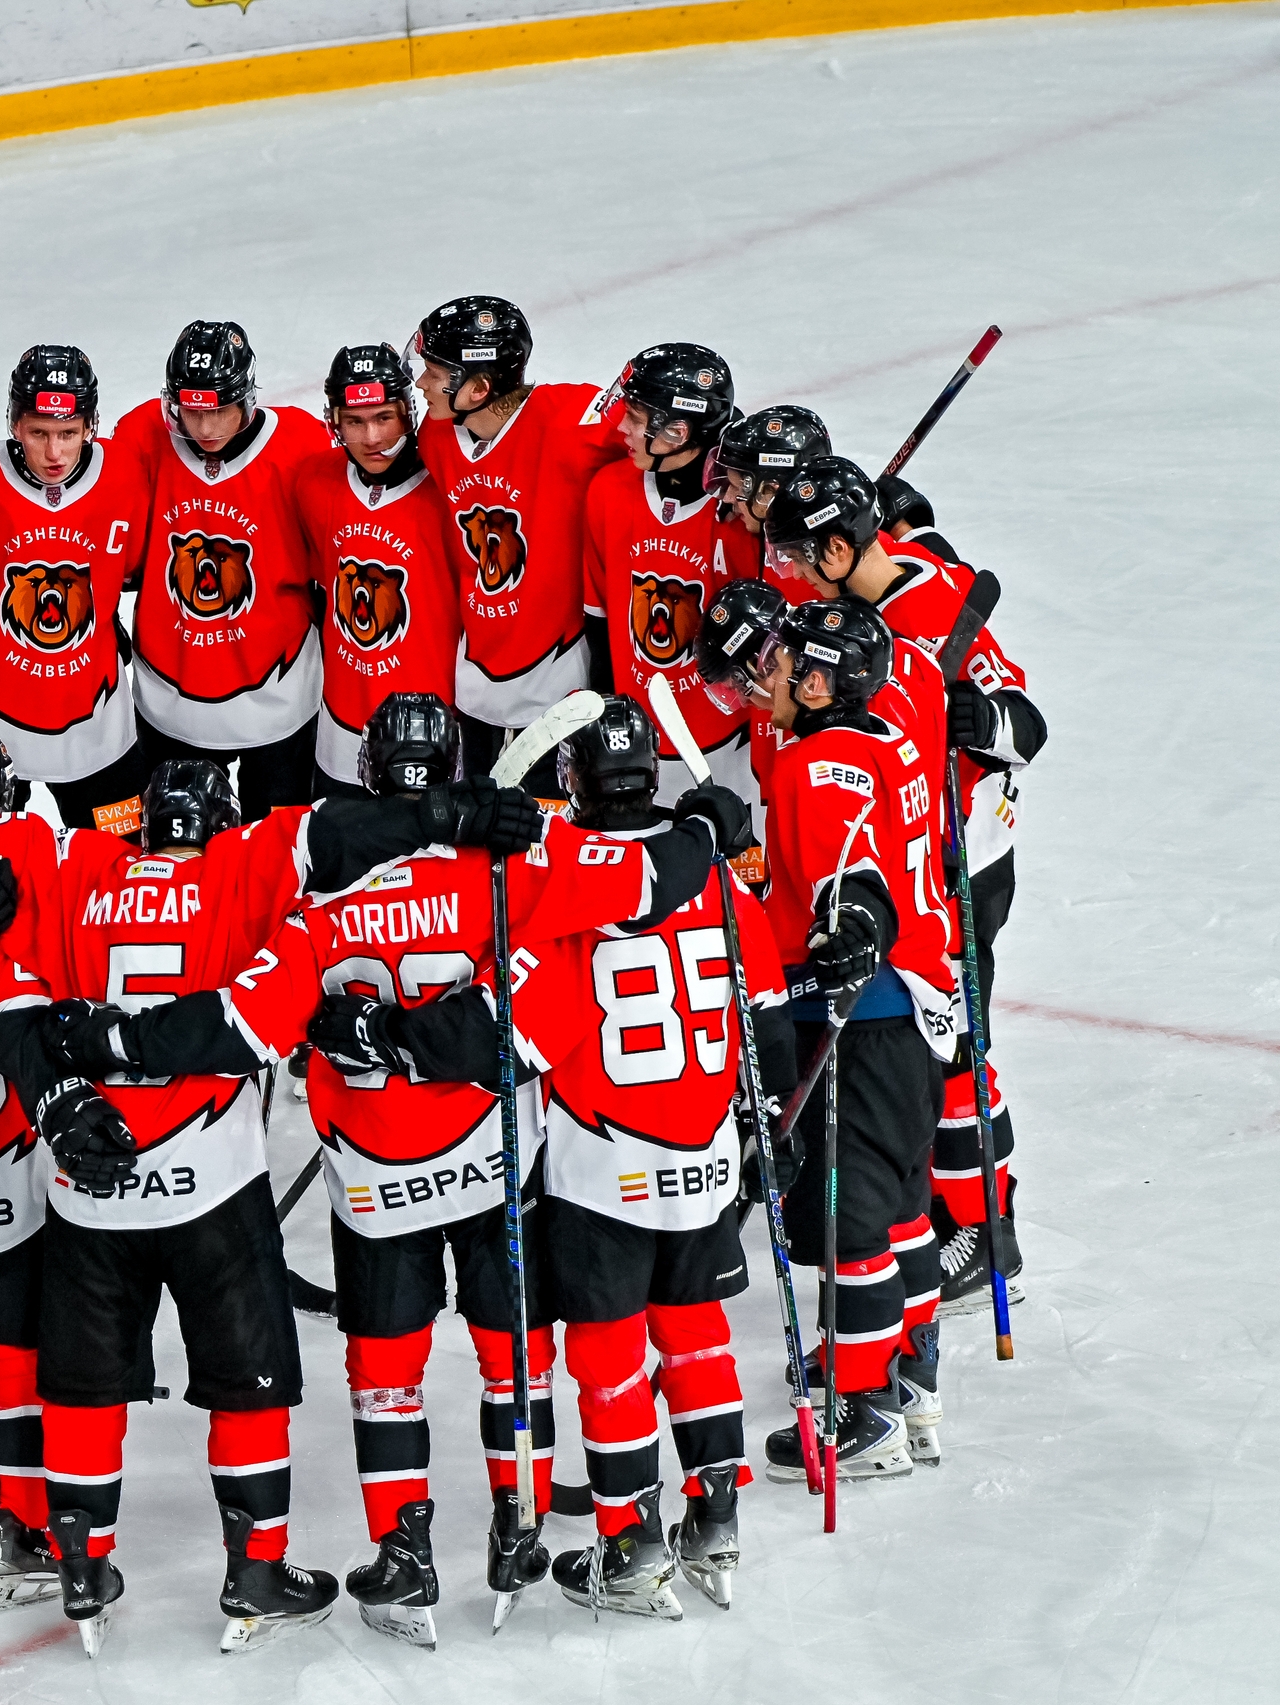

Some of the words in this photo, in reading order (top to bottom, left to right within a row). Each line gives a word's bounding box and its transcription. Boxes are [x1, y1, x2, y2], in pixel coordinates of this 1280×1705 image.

[189, 353, 212, 368] 23
[470, 351, 494, 359] ЕВРАЗ
[353, 360, 374, 373] 80
[47, 371, 67, 384] 48
[38, 404, 72, 413] OLIMPBET
[181, 400, 215, 408] OLIMPBET
[348, 396, 382, 405] OLIMPBET
[681, 400, 705, 410] ЕВРАЗ
[768, 456, 792, 464] ЕВРАЗ
[163, 498, 259, 536] КУЗНЕЦКИЕ
[813, 506, 837, 524] ЕВРАЗ
[106, 520, 130, 555] C
[333, 523, 414, 560] КУЗНЕЦКИЕ
[630, 537, 708, 575] УЗНЕЦКИЕ
[713, 538, 728, 576] A
[730, 626, 749, 648] ЕВРАЗ
[337, 644, 401, 676] МЕДВЕДИ
[813, 646, 838, 660] ЕВРАЗ
[5, 650, 91, 678] МЕДВЕДИ
[967, 649, 1017, 695] 84
[609, 731, 630, 750] 85
[404, 766, 427, 785] 92
[832, 767, 871, 790] ЕВР
[97, 800, 141, 823] EVRAZ
[101, 819, 138, 835] STEEL
[172, 819, 184, 838] 5
[143, 866, 168, 874] БАНК
[382, 874, 407, 883] БАНК
[592, 927, 731, 1086] 85
[956, 868, 993, 1131] SHERWOOD
[378, 1150, 505, 1210] ЕВРАЗ
